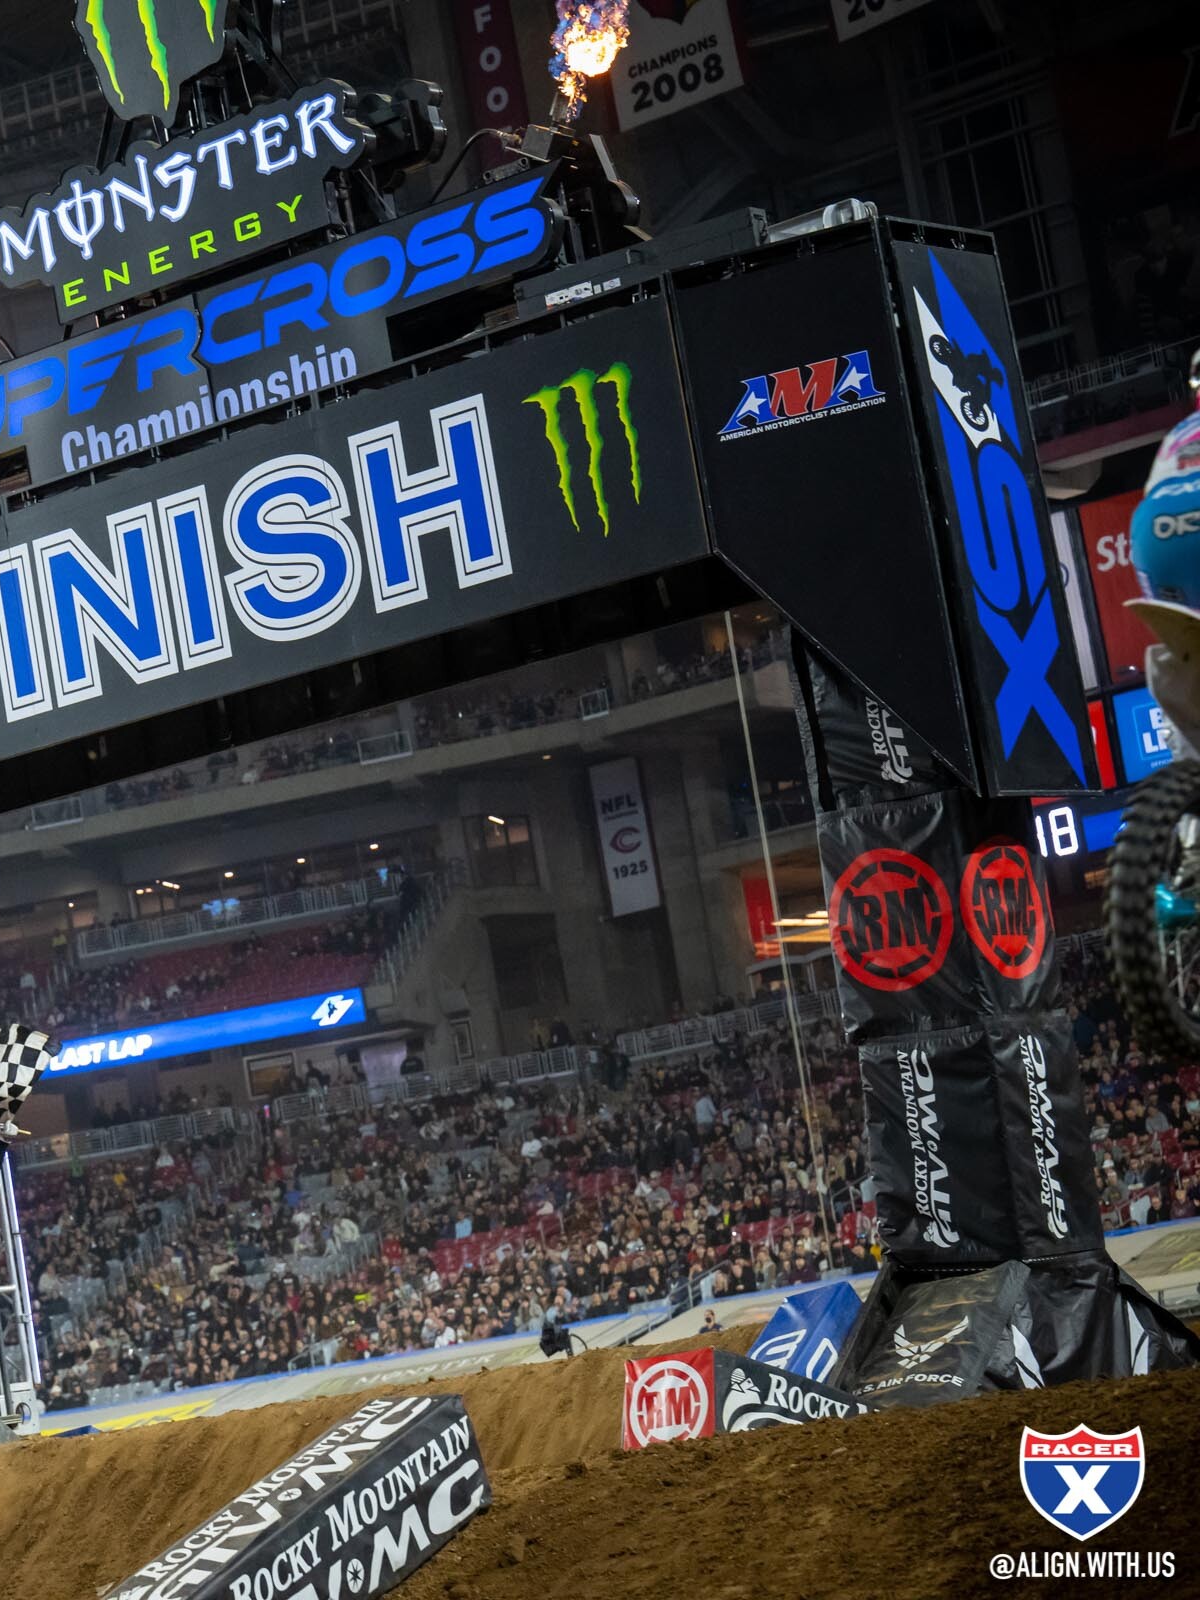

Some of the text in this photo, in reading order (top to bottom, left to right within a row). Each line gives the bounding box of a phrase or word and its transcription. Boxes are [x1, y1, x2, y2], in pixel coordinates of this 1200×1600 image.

[628, 35, 718, 79] CHAMPIONS
[631, 53, 725, 113] 2008
[64, 195, 302, 307] ENERGY
[61, 346, 357, 473] Championship
[717, 350, 886, 435] AMA
[720, 397, 886, 442] AMERICAN MOTORCYCLIST ASSOCIATION
[865, 696, 890, 757] ROCKY
[601, 794, 637, 815] NFL
[612, 860, 649, 880] 1925
[49, 1034, 152, 1072] LAST LAP
[897, 1049, 932, 1218] ROCKY MOUNTAIN
[1018, 1034, 1052, 1208] ROCKY MOUNTAIN
[764, 1373, 851, 1420] ROCKY
[876, 1377, 904, 1393] AIR
[904, 1373, 965, 1388] FORCE
[144, 1399, 394, 1583] ROCKY MOUNTAIN
[229, 1415, 470, 1600] ROCKY MOUNTAIN
